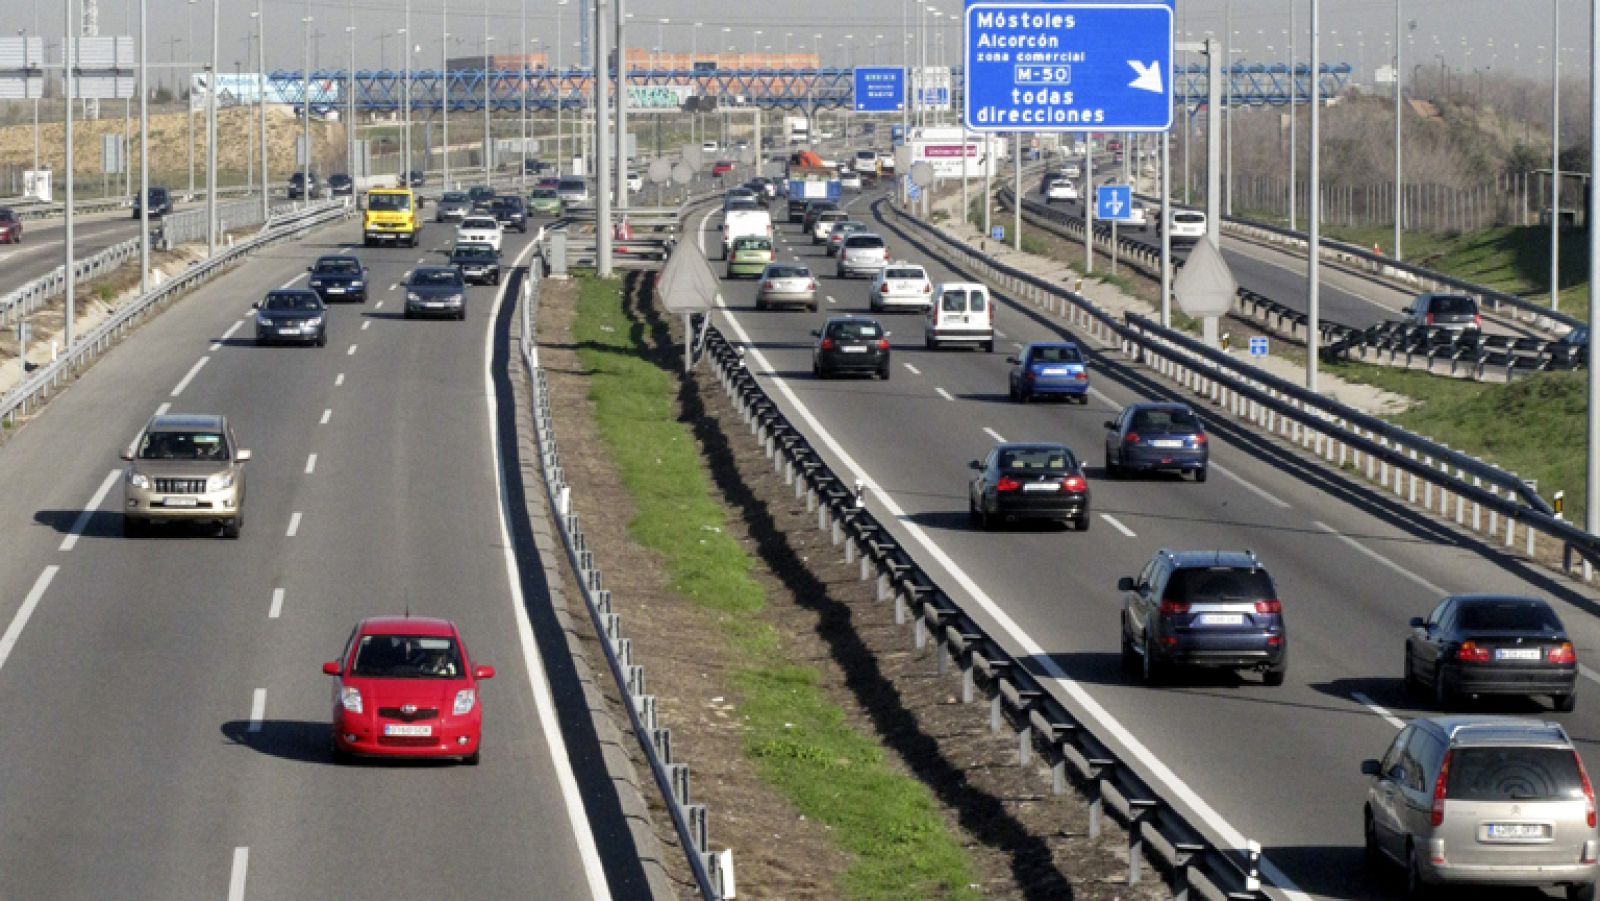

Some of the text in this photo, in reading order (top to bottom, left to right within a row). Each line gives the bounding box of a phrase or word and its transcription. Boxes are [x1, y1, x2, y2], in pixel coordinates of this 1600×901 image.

[977, 12, 1075, 28] Móstoles
[977, 33, 1058, 48] Alcorcón
[977, 52, 1084, 61] zona comercial
[1017, 68, 1068, 82] M-50
[1012, 88, 1073, 104] todas
[977, 106, 1104, 123] direcciones
